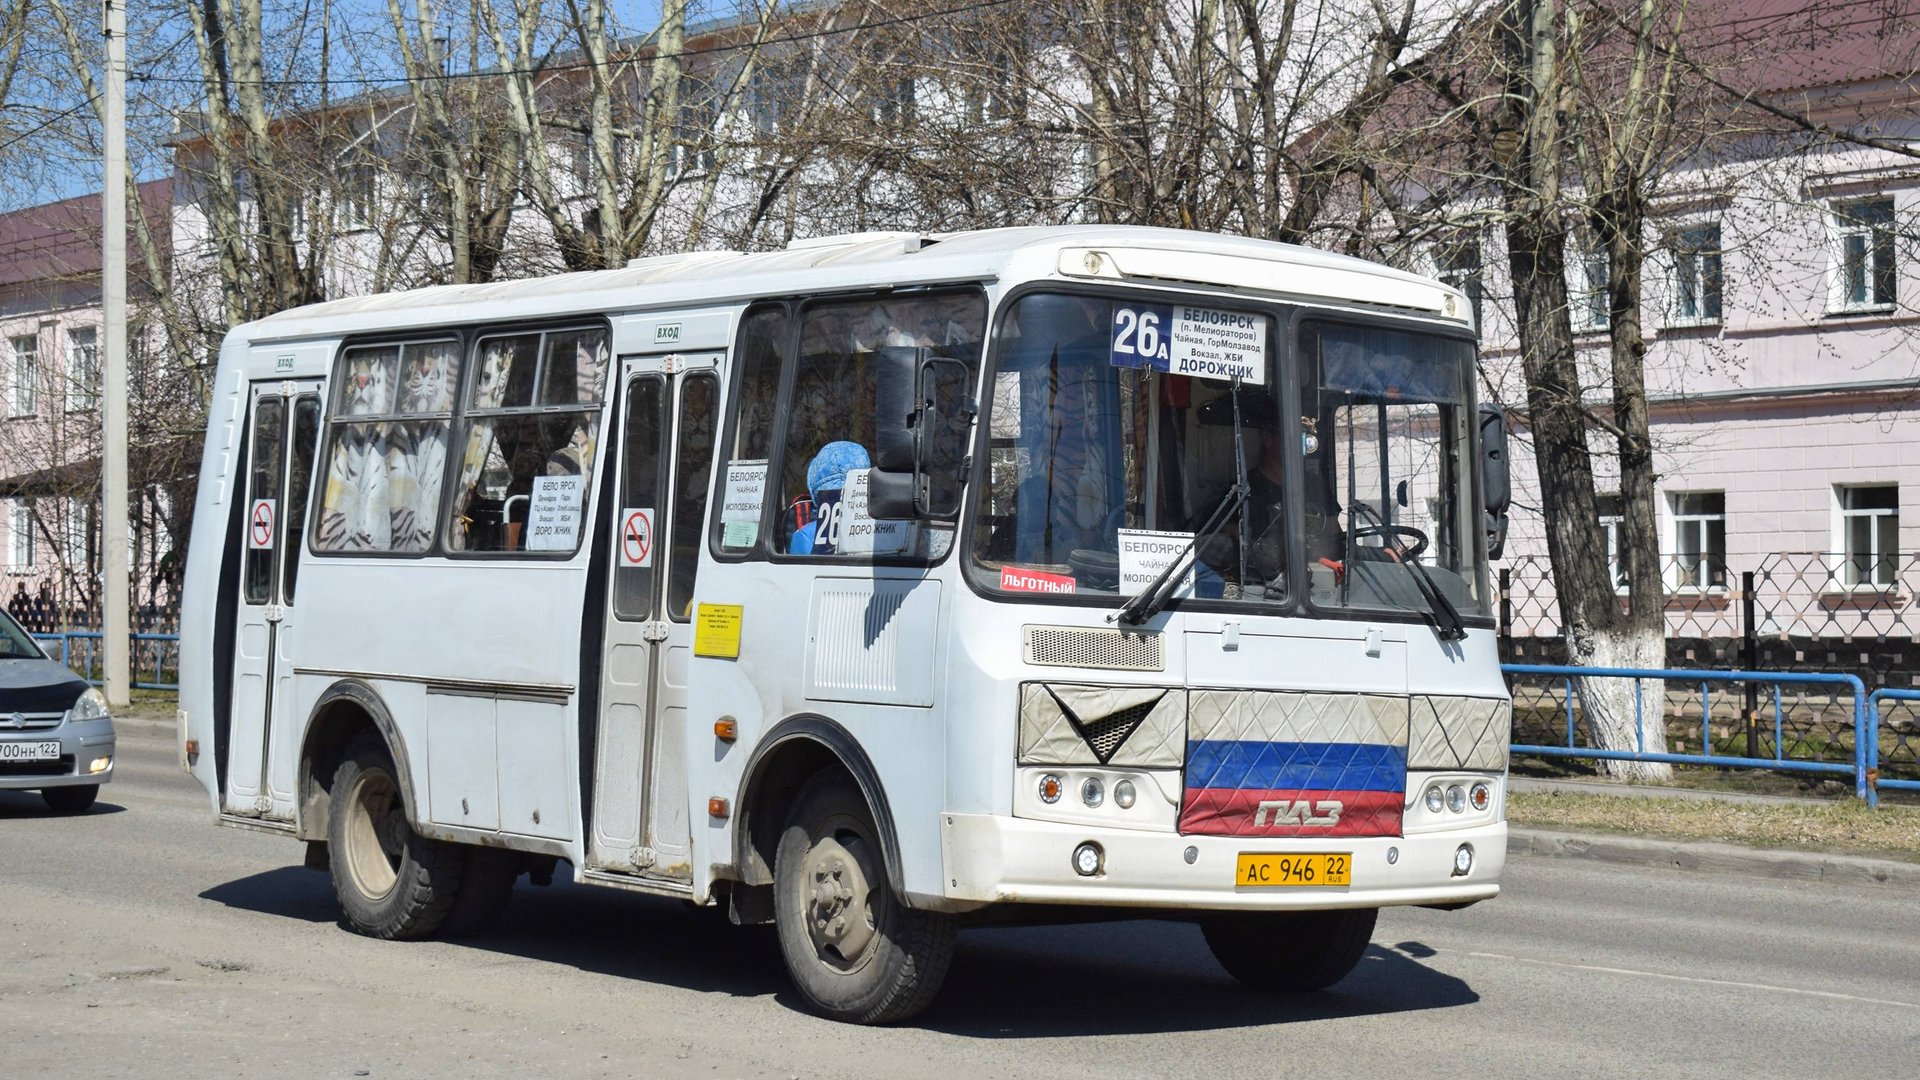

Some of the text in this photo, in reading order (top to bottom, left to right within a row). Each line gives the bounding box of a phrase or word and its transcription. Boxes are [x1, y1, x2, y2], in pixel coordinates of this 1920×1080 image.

[1183, 308, 1255, 330] БЕЛОЯРСК
[657, 327, 678, 339] ВХОД
[1180, 322, 1257, 342] (п. Мелиораторов)
[1174, 333, 1261, 353] Чайная, ГорМолзавод
[1191, 348, 1243, 362] Вокзал, ЖБИ
[277, 358, 293, 368] ВХОД
[1178, 359, 1254, 379] ДОРОЖНИК
[543, 481, 576, 491] БЕЛО ЯРСК
[856, 474, 868, 485] БЕ
[736, 484, 758, 494] ЧАЙНАЯ
[534, 526, 572, 536] ДОРО ЖНИК
[849, 523, 897, 537] ДОРО ЖНИК
[1138, 559, 1172, 569] ЧАЙНА
[1003, 574, 1073, 593] ЛЬГОТНЫЙ
[39, 743, 57, 754] 122
[1254, 800, 1344, 827] ПАЗ
[1247, 857, 1345, 882] АС 946 22
